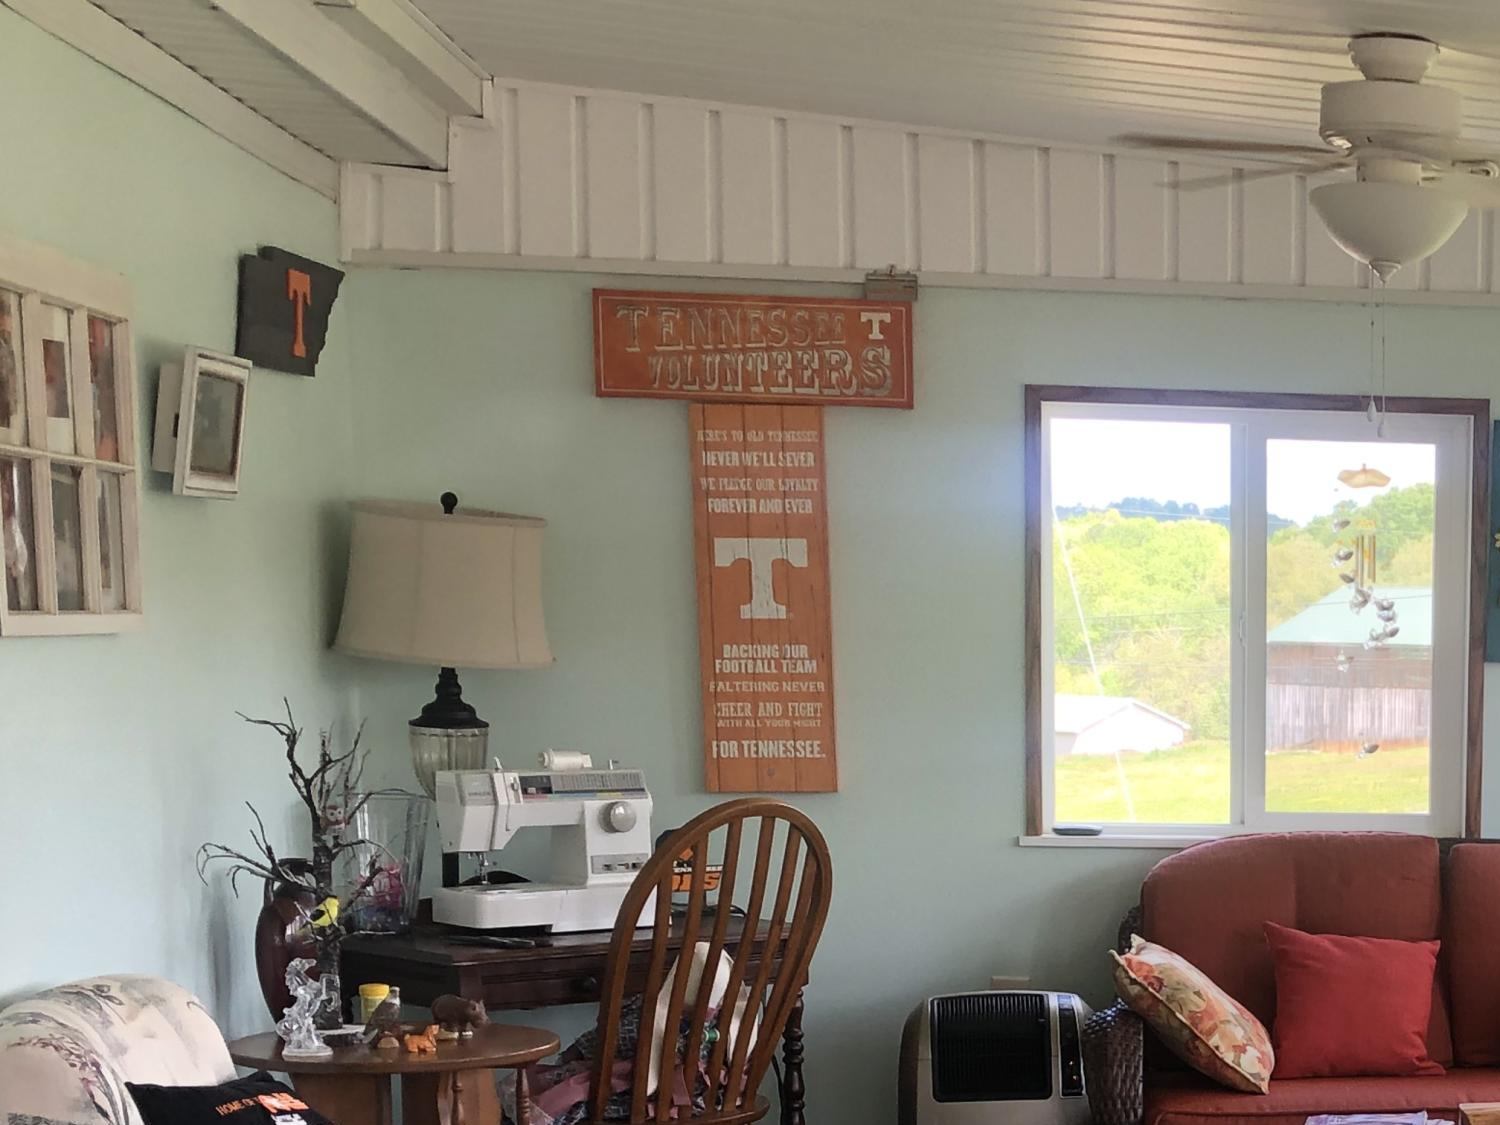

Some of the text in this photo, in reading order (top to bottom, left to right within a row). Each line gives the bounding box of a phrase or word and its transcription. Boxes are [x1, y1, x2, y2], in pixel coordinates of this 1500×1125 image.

[287, 268, 311, 358] T
[616, 304, 846, 352] TENNESSEE
[859, 311, 892, 340] T
[648, 346, 892, 397] VOLUNTEERS
[731, 430, 743, 442] TO
[702, 451, 816, 467] NEVER WE'LL SEVER
[700, 477, 716, 491] WE
[755, 478, 775, 491] OUR
[778, 478, 819, 492] LOYALTY
[707, 498, 813, 514] FOREVER AND EVER
[713, 537, 809, 619] T
[722, 643, 809, 659] BACKING OUR
[715, 659, 817, 674] FOOTBALL TEAM
[708, 680, 825, 693] FALTERING NEVER
[713, 702, 823, 717] CHEER AND FIGHT
[716, 719, 743, 728] WITH
[744, 719, 762, 728] ALL
[765, 719, 791, 728] YOUR
[711, 739, 826, 759] FOR TENNESSEE.
[215, 1100, 244, 1116] HOME
